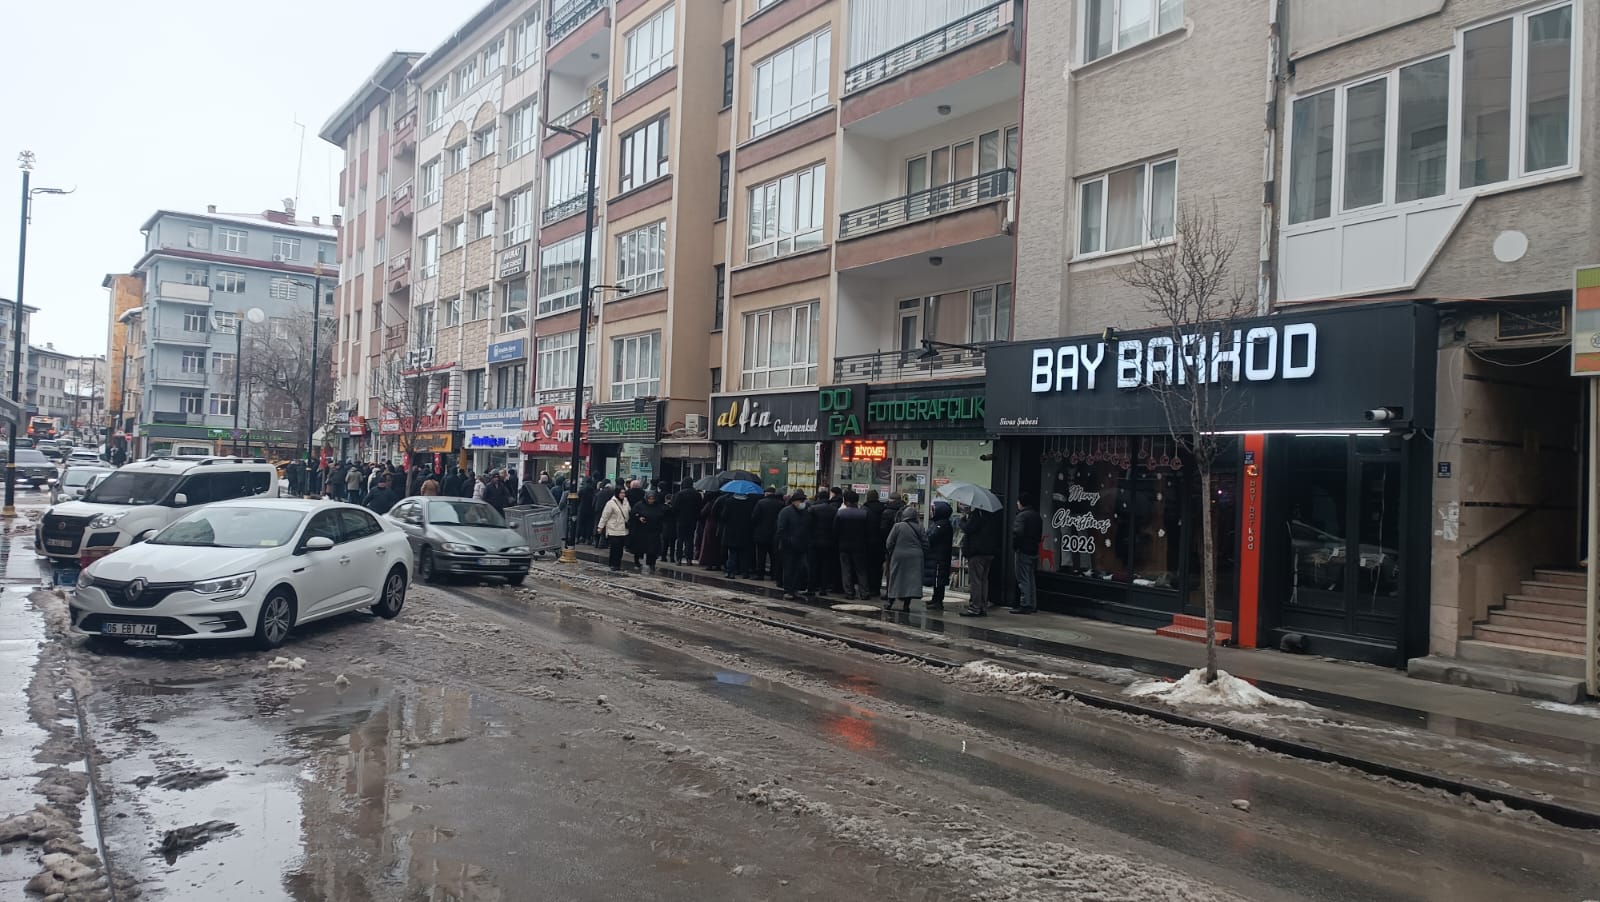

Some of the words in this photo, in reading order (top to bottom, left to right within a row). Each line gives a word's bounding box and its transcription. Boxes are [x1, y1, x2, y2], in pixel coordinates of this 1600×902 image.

[1031, 342, 1105, 393] BAY
[1117, 322, 1317, 389] BARKOD
[818, 388, 852, 412] DO
[867, 394, 985, 424] FOTOĞRAFÇILIK
[630, 416, 648, 431] Bella
[773, 418, 818, 437] Gayrimenkul
[828, 411, 862, 436] ĞA
[999, 417, 1016, 426] Sivas
[1016, 416, 1039, 427] Şubesi
[1068, 485, 1101, 506] Merry
[1051, 507, 1111, 534] Christmas
[1061, 534, 1096, 554] 2026
[107, 623, 117, 633] 06
[140, 624, 155, 635] 744
